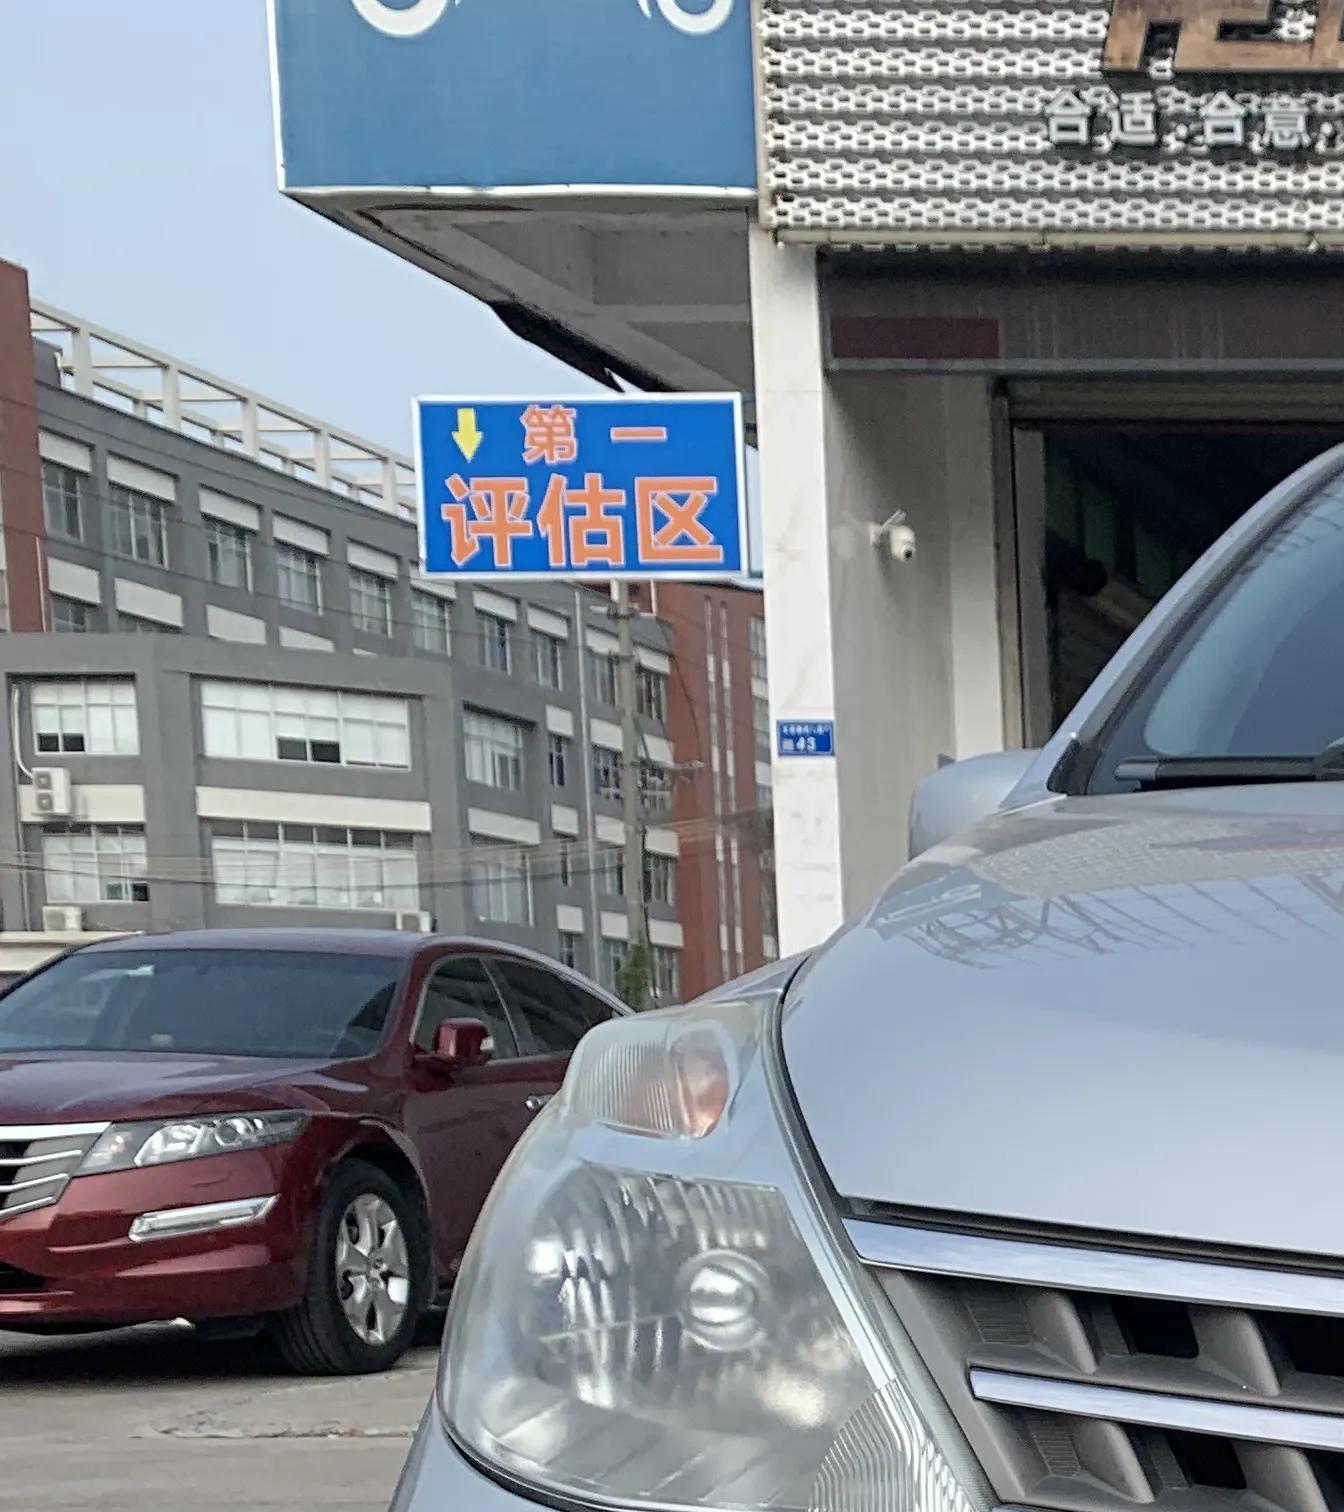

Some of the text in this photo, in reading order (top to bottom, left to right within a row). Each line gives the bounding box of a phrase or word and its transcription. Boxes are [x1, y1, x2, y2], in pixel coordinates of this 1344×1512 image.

[521, 404, 667, 465] 第一
[441, 473, 724, 567] 评估区
